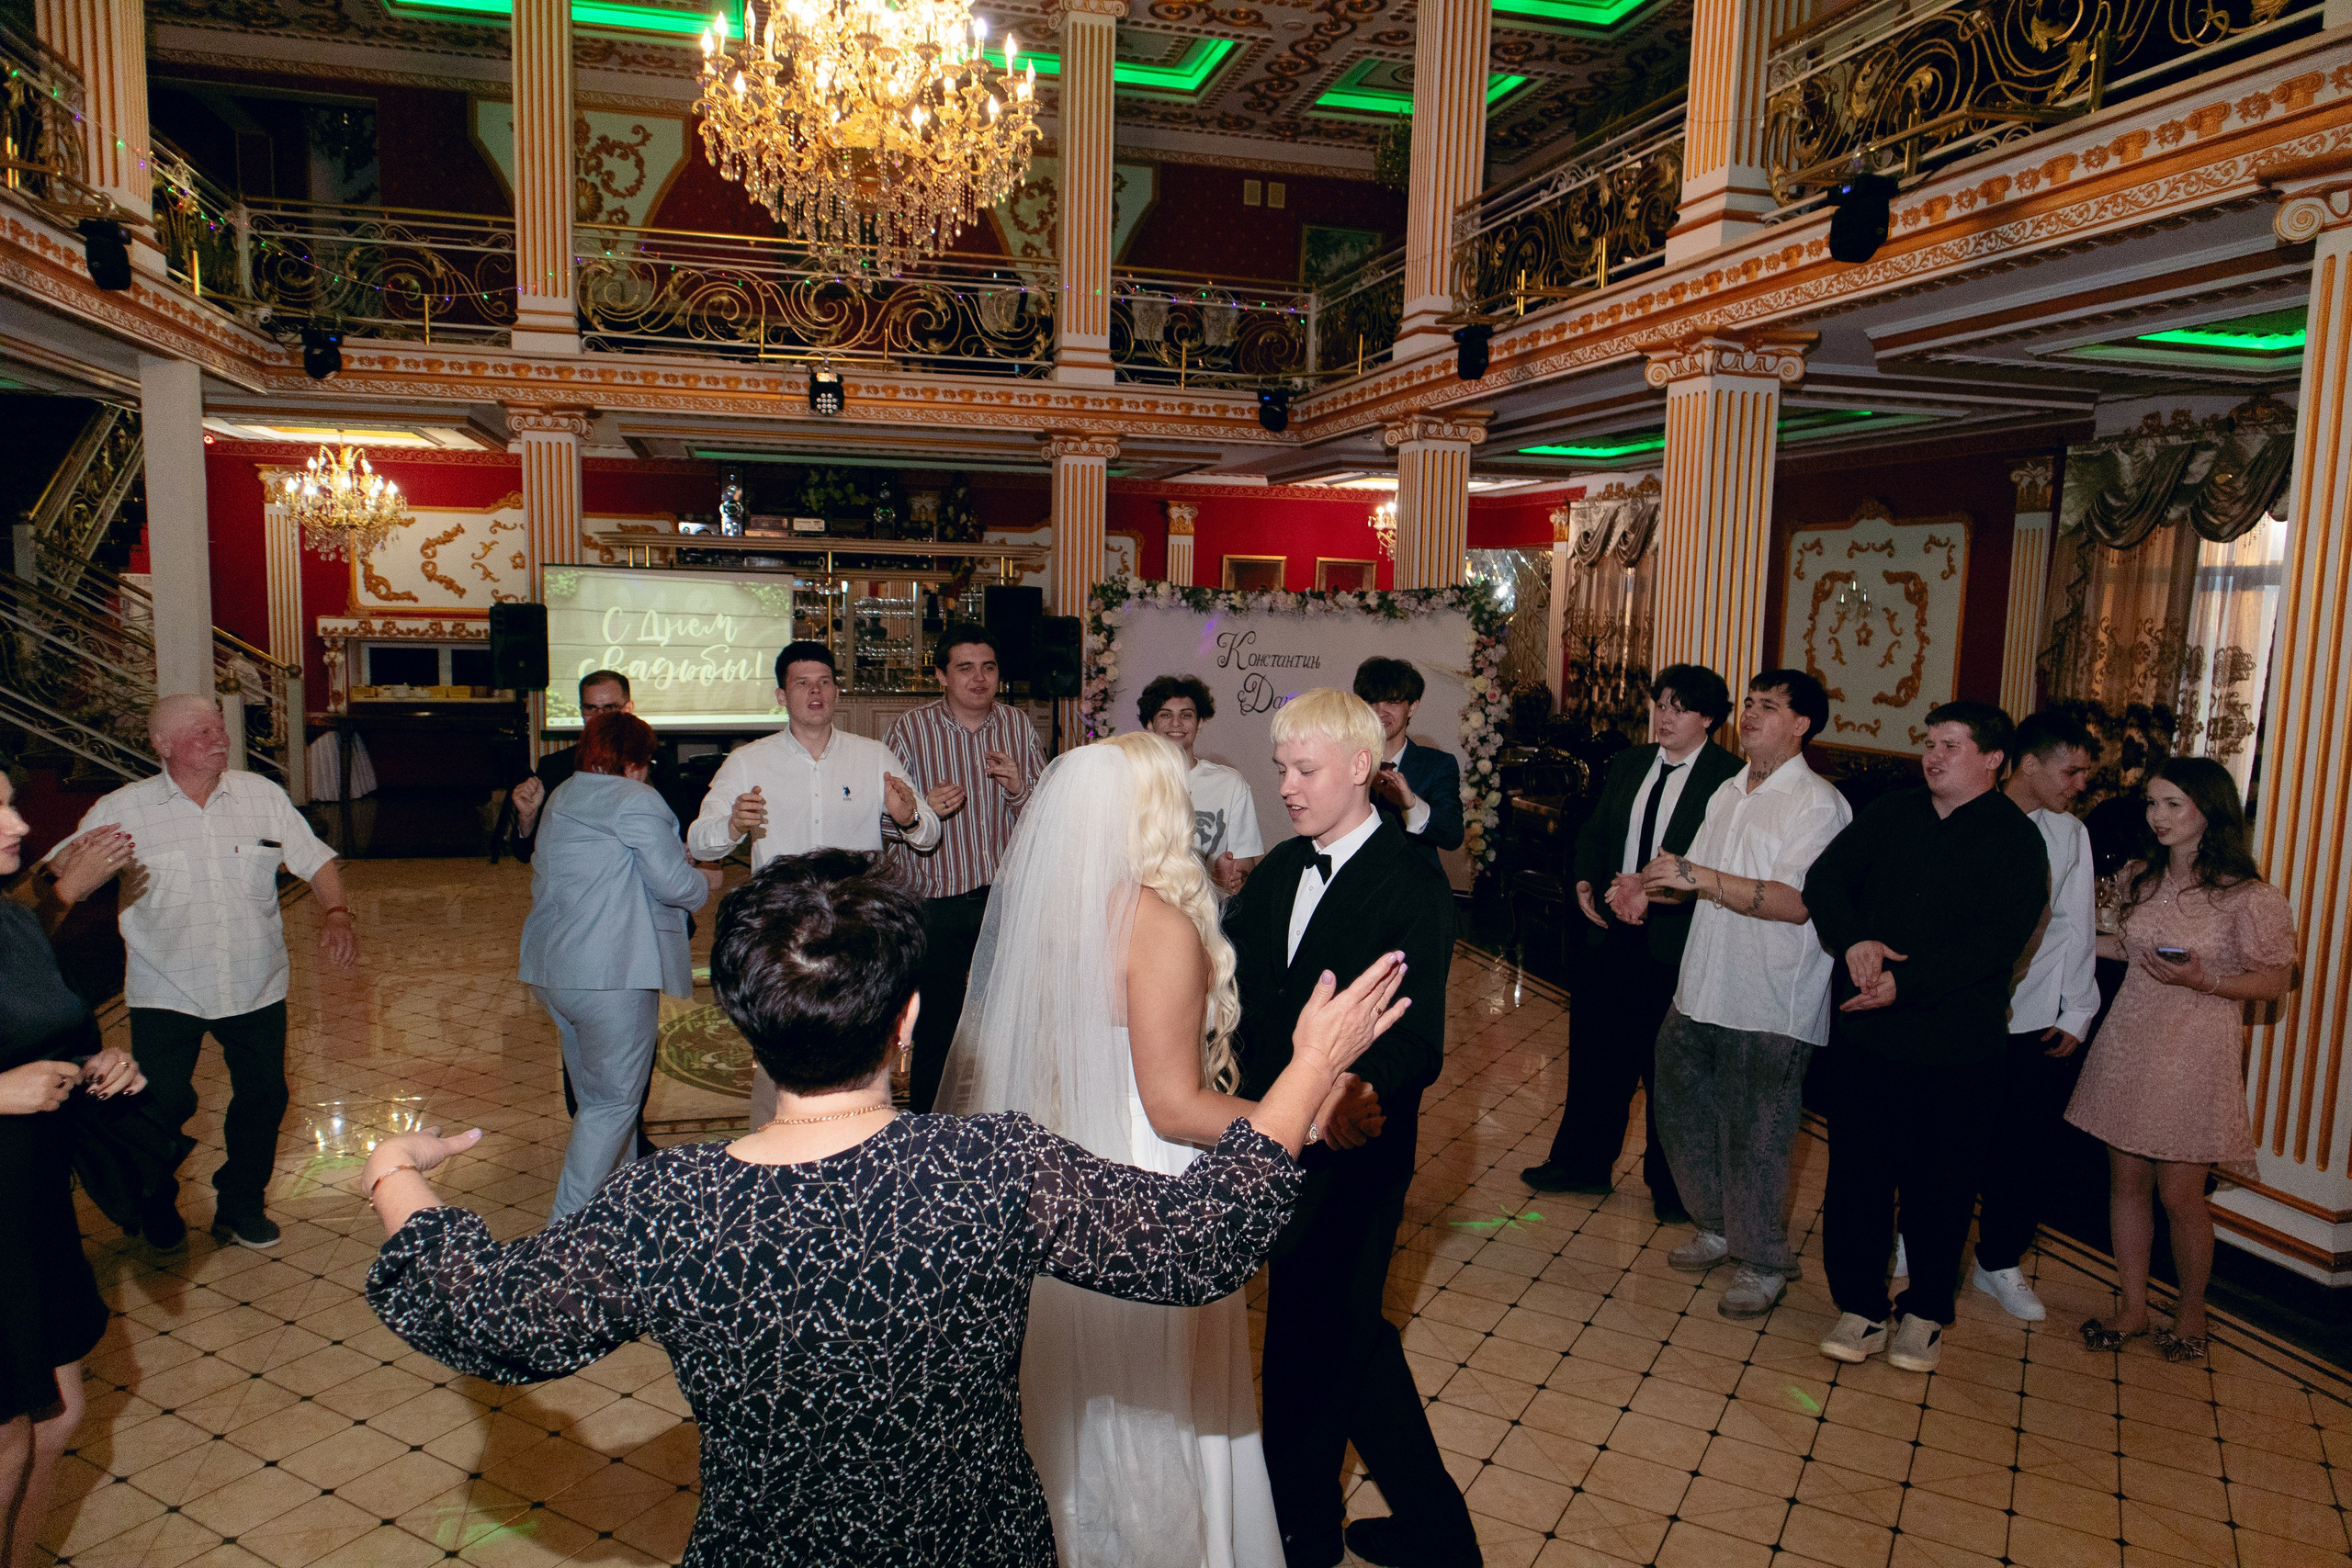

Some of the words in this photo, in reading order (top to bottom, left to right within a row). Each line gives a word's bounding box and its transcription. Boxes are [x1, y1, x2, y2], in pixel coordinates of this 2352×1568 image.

[602, 605, 631, 644] С
[636, 608, 739, 648] Днем
[1216, 630, 1321, 671] Константин
